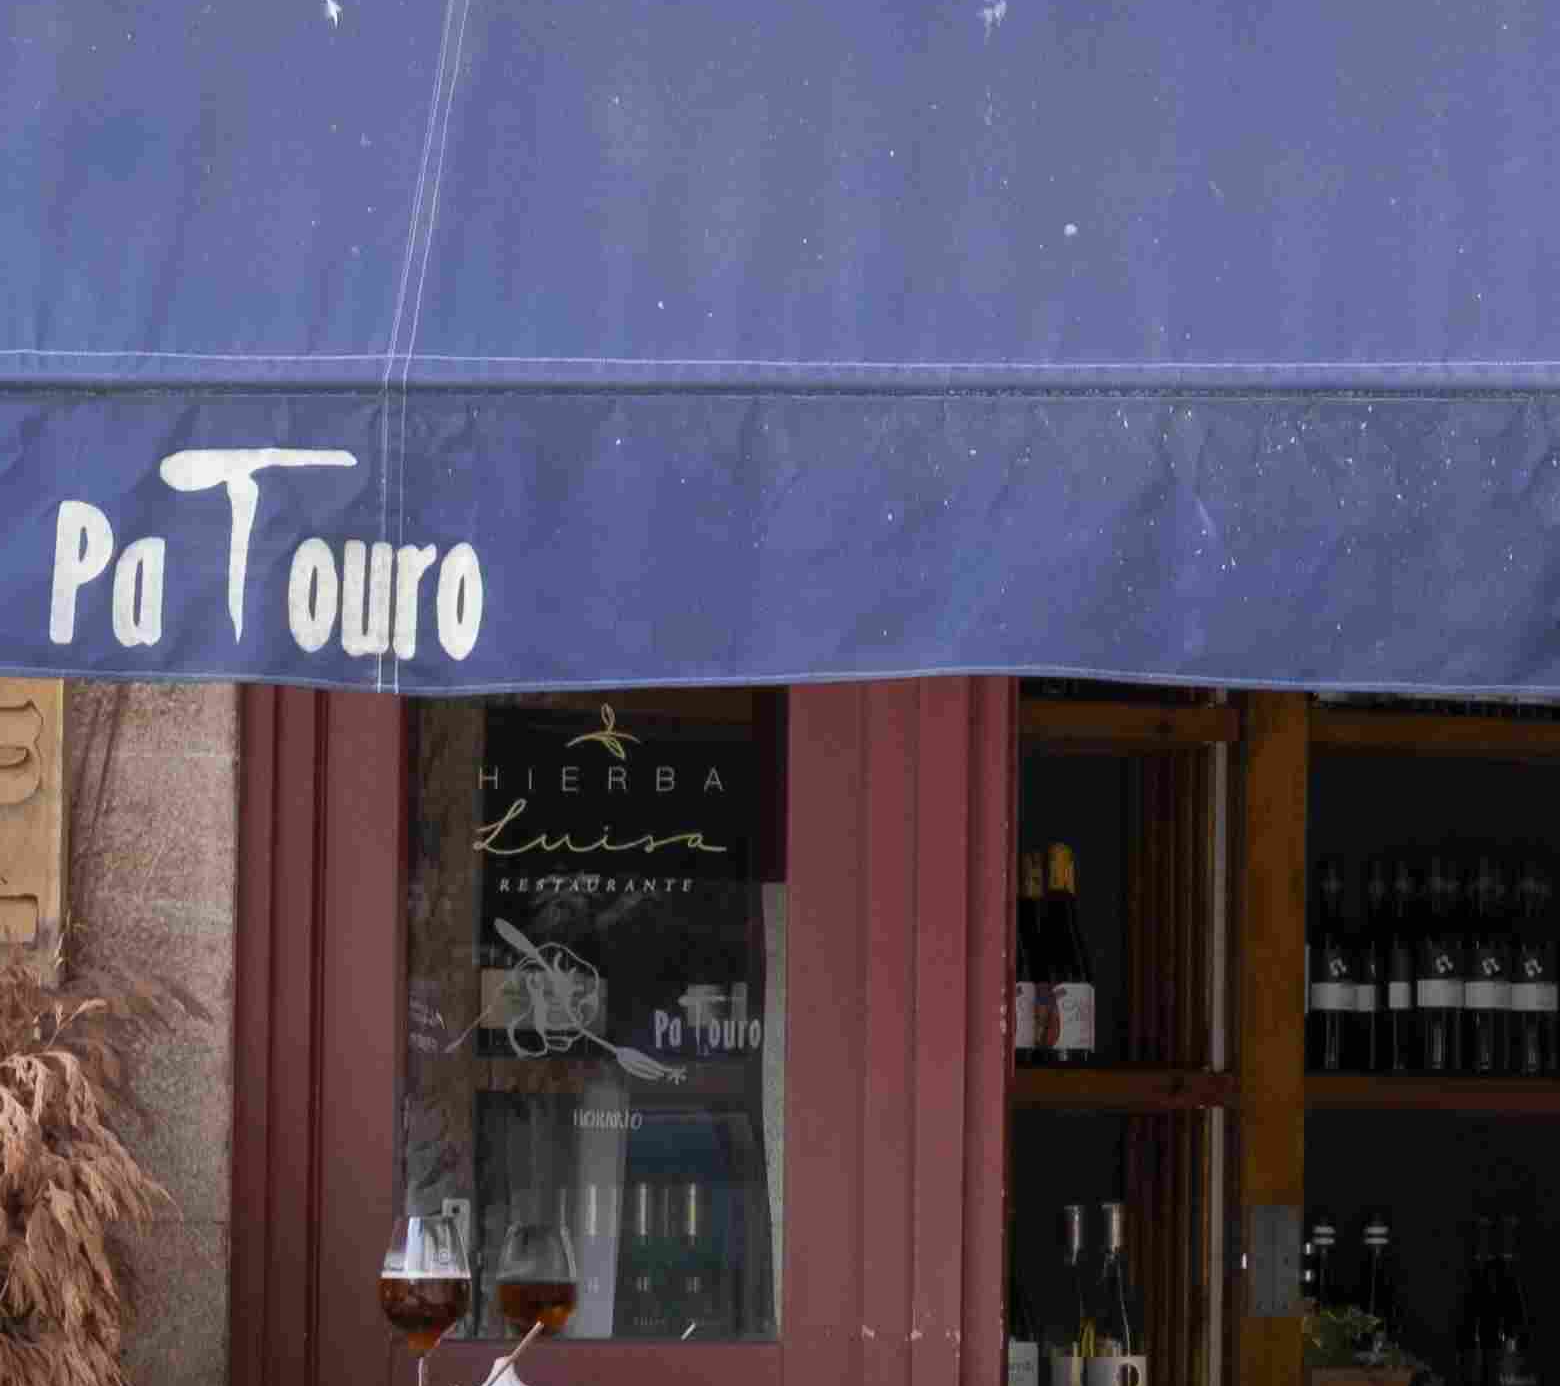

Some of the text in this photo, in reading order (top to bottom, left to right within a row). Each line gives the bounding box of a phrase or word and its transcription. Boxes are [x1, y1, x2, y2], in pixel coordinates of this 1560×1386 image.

[49, 447, 484, 661] Pa Touro
[478, 766, 726, 792] HIERBA
[472, 798, 728, 854] Luisa
[499, 878, 695, 893] RESTAURANTE
[654, 1010, 682, 1049] Pa
